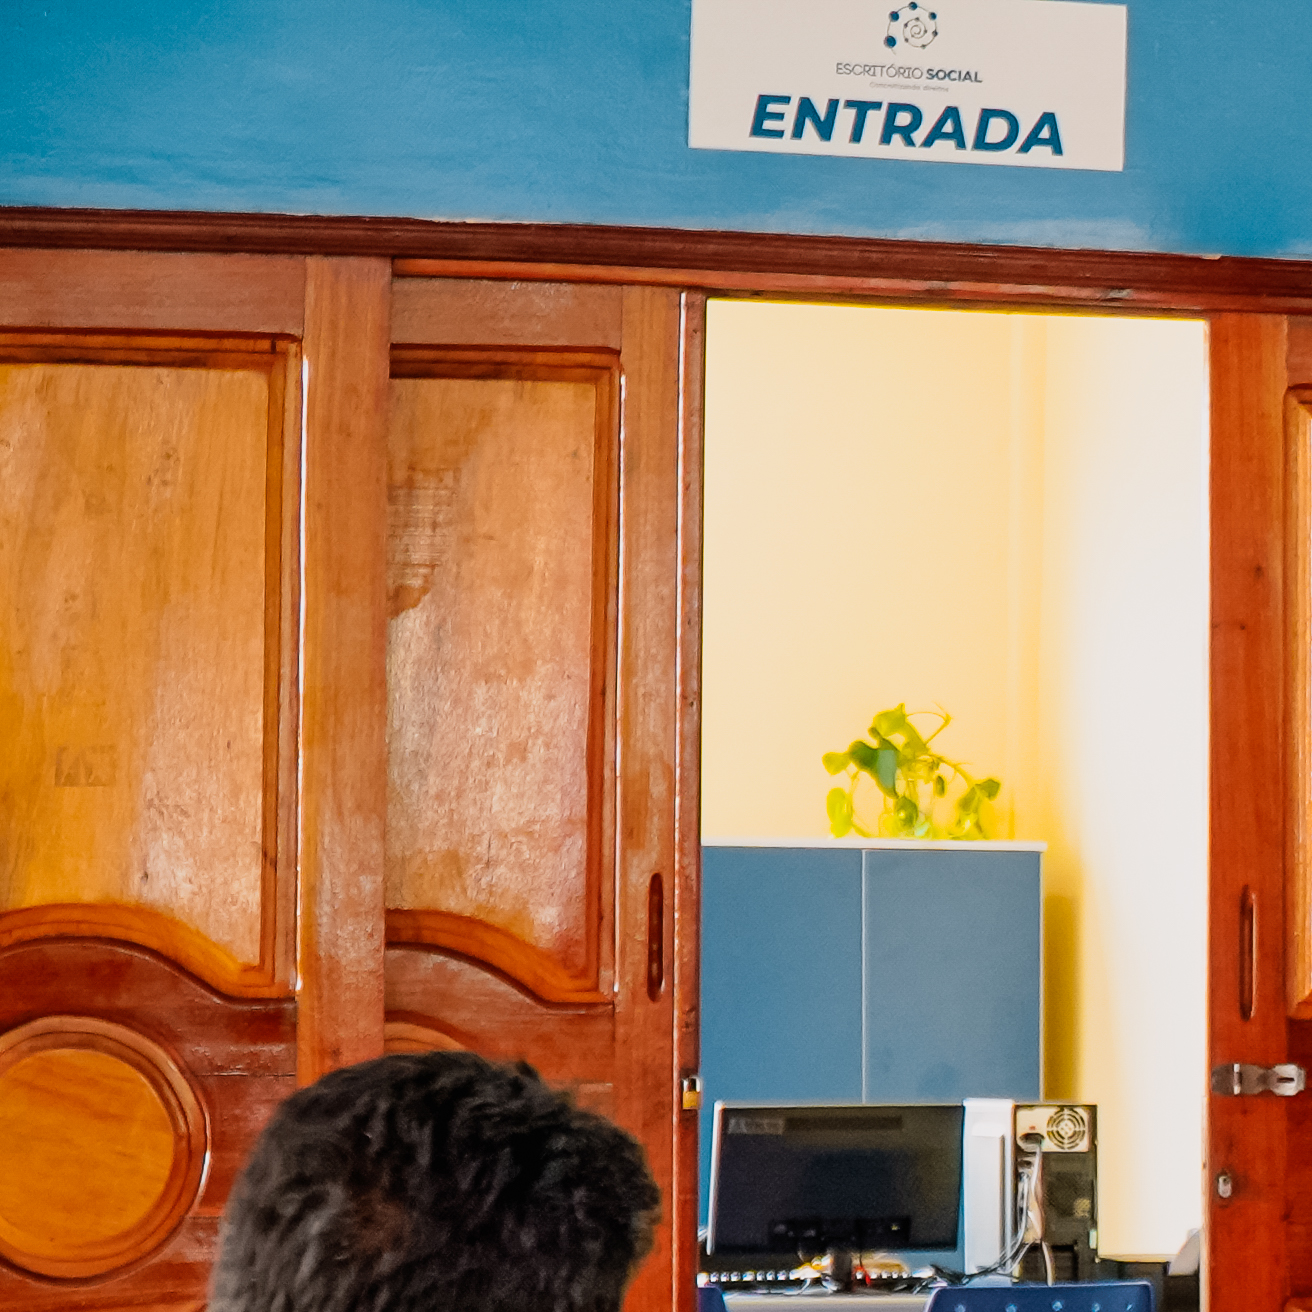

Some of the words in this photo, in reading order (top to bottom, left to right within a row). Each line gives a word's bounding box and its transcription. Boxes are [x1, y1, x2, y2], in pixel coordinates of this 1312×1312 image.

[835, 62, 923, 80] ESCRITÓRIO
[925, 68, 983, 83] SOCIAL
[748, 93, 1064, 157] ENTRADA
